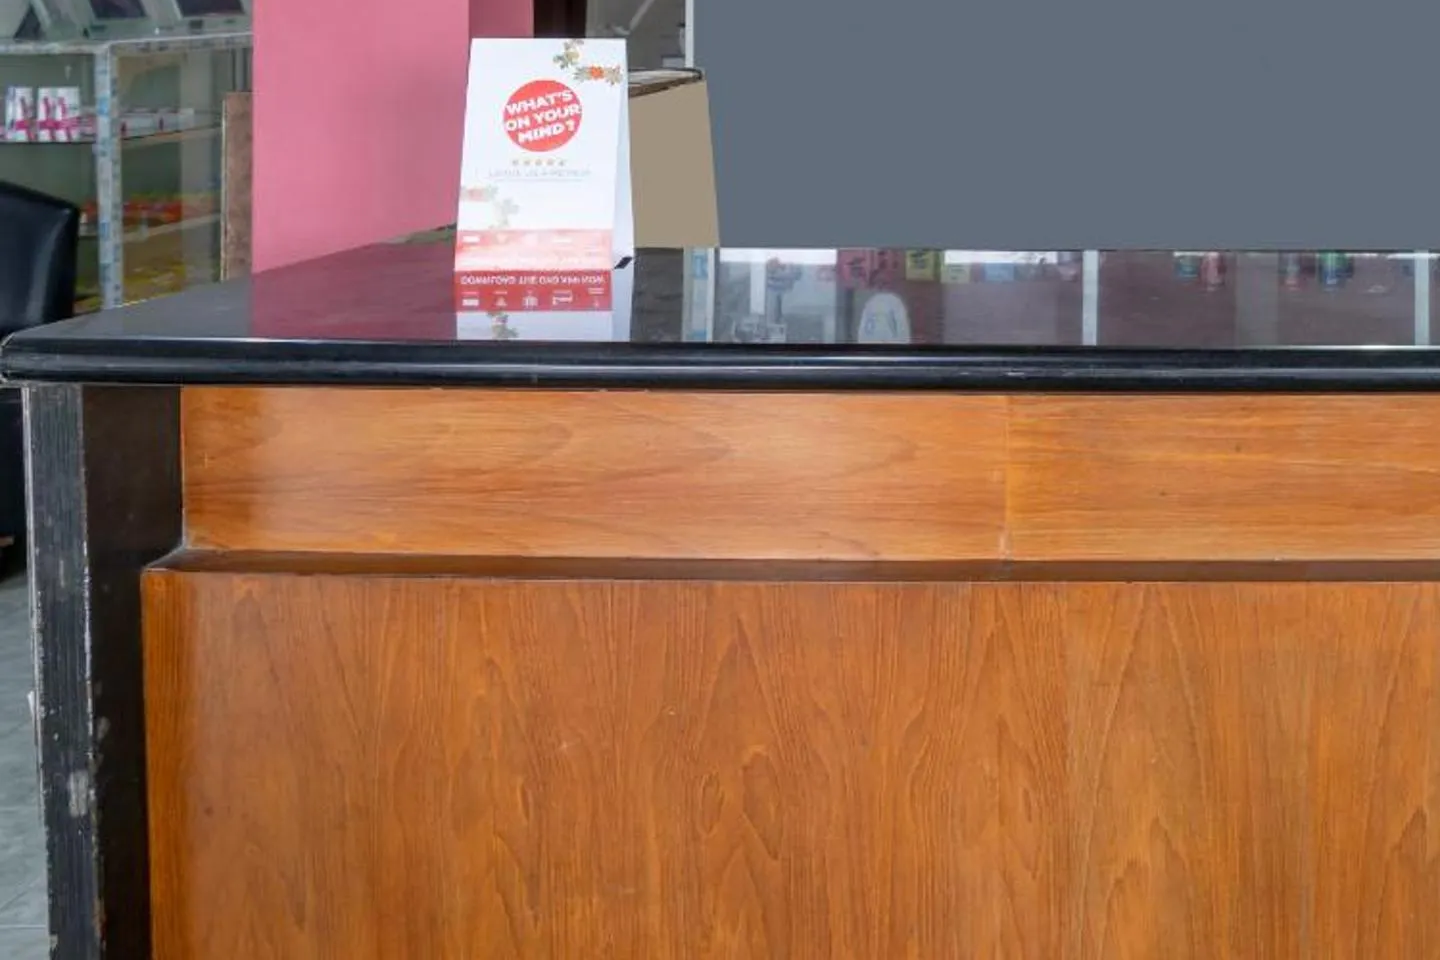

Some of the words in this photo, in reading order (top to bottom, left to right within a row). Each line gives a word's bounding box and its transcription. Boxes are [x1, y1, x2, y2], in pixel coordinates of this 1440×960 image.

[506, 89, 573, 115] WHAT'S
[506, 115, 531, 131] ON
[532, 103, 581, 124] YOUR
